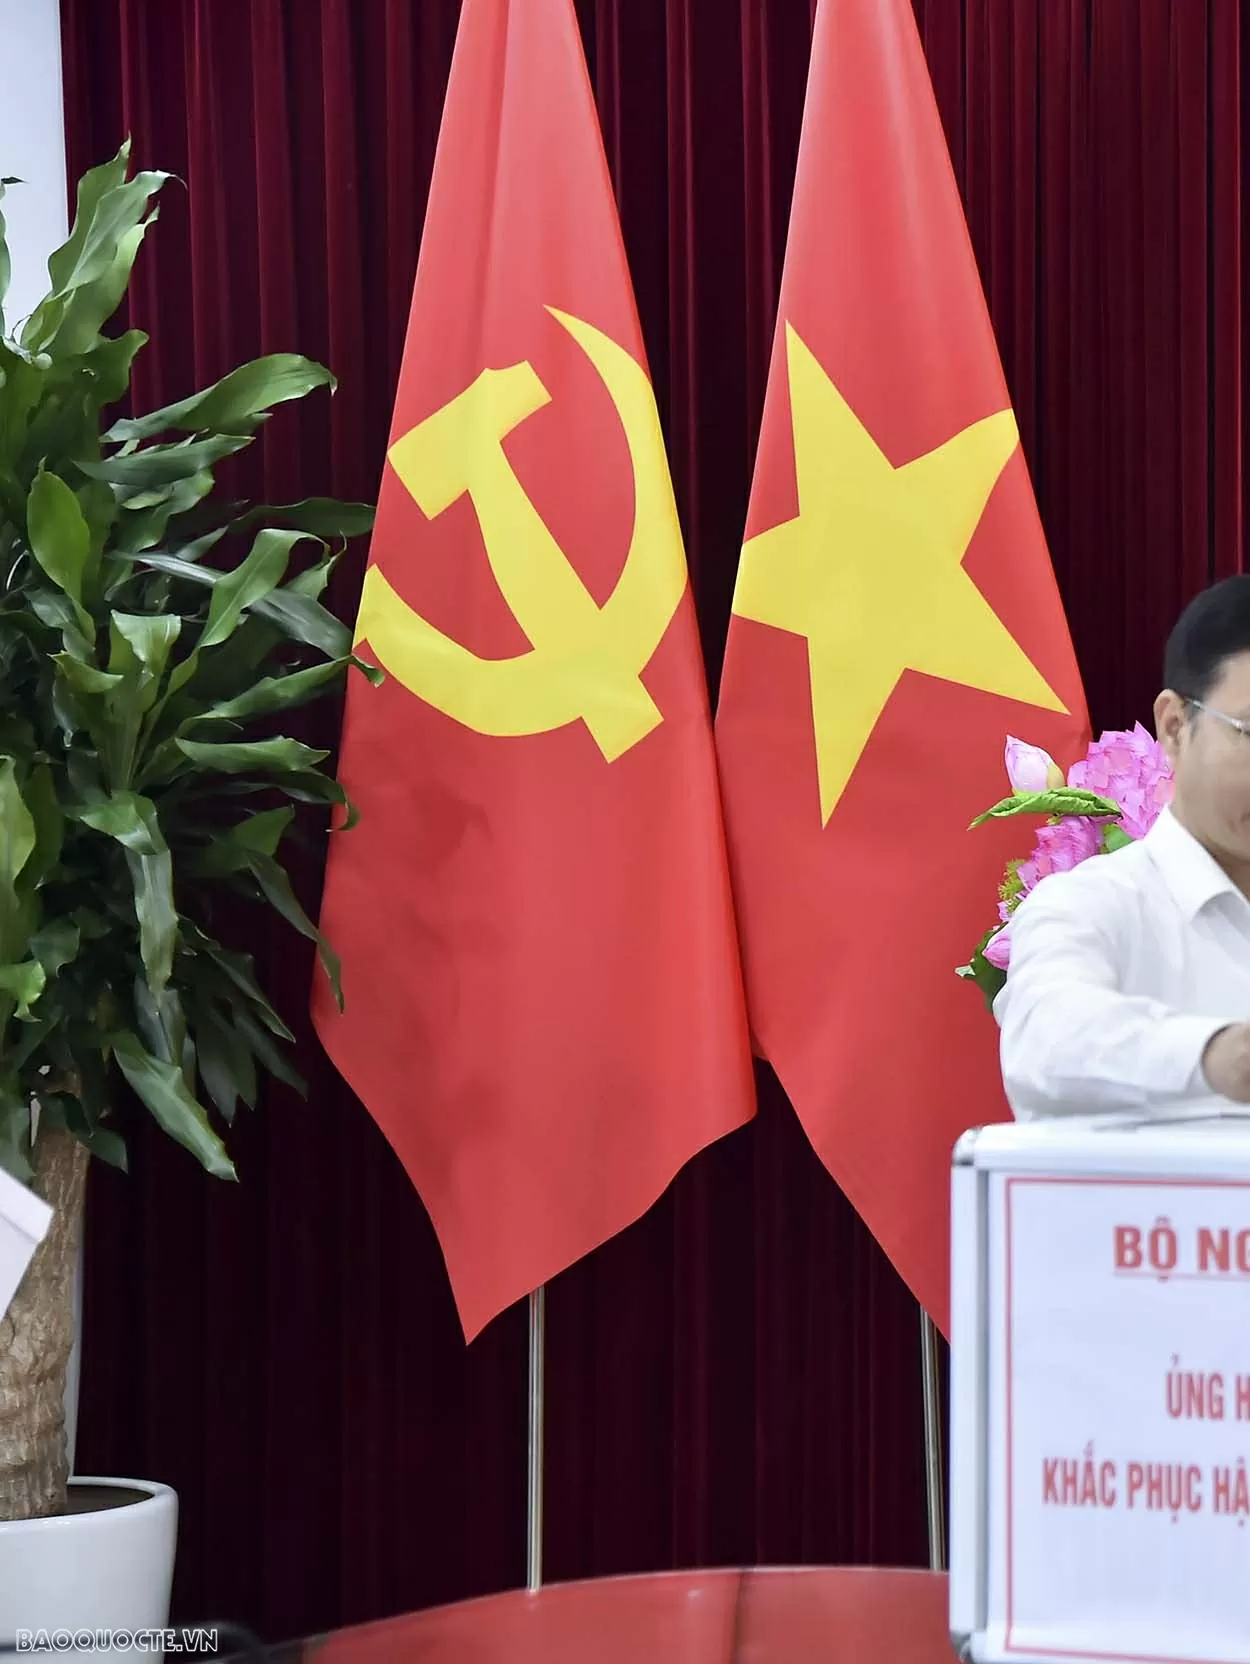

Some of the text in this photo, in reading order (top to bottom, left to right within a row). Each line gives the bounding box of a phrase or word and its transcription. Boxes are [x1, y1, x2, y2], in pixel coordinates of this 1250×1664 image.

[1113, 1216, 1178, 1283] BỘ
[1042, 1439, 1118, 1508] KHẮC
[1126, 1461, 1203, 1525] PHỤC
